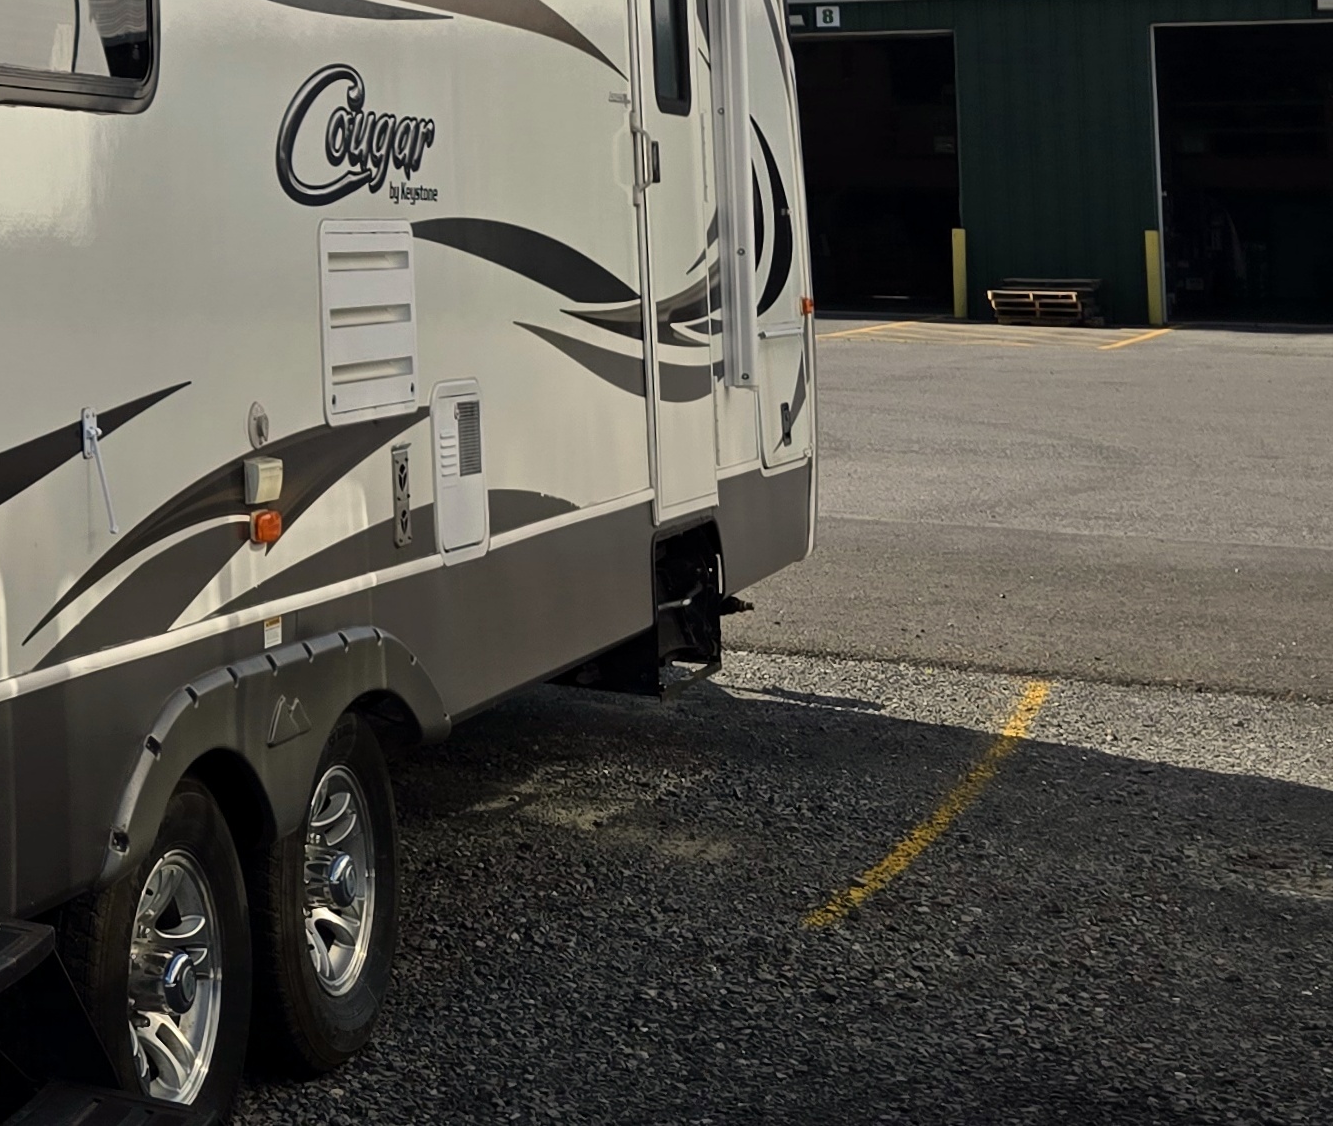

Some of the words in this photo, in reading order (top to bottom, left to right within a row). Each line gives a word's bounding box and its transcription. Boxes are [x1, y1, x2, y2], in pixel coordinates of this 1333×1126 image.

[276, 63, 435, 206] Cougar
[389, 181, 399, 204] by
[401, 182, 438, 205] Keystone
